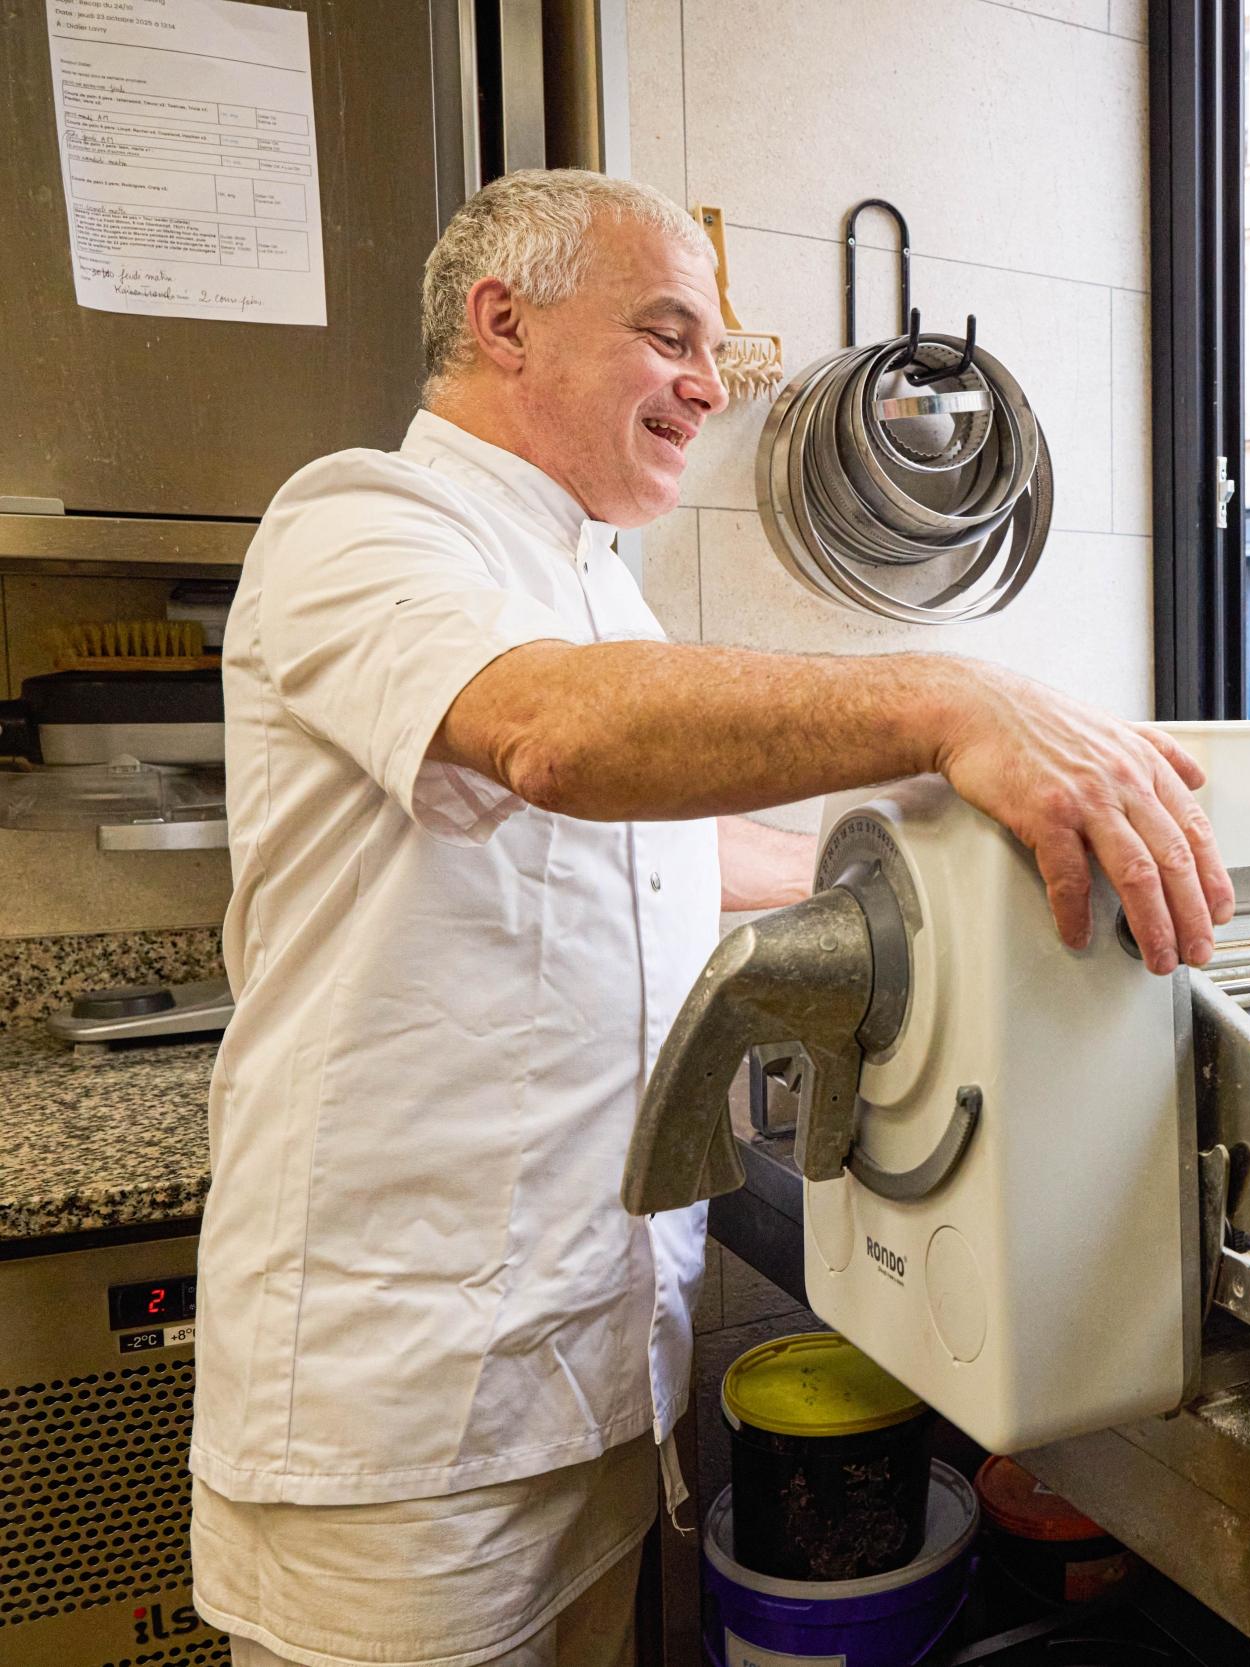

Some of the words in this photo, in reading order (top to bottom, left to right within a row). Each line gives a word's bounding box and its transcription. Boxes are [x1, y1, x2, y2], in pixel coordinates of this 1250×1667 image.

[106, 15, 134, 23] octobre
[136, 18, 152, 26] 2025
[66, 22, 87, 31] Didier
[133, 1604, 211, 1645] ils
